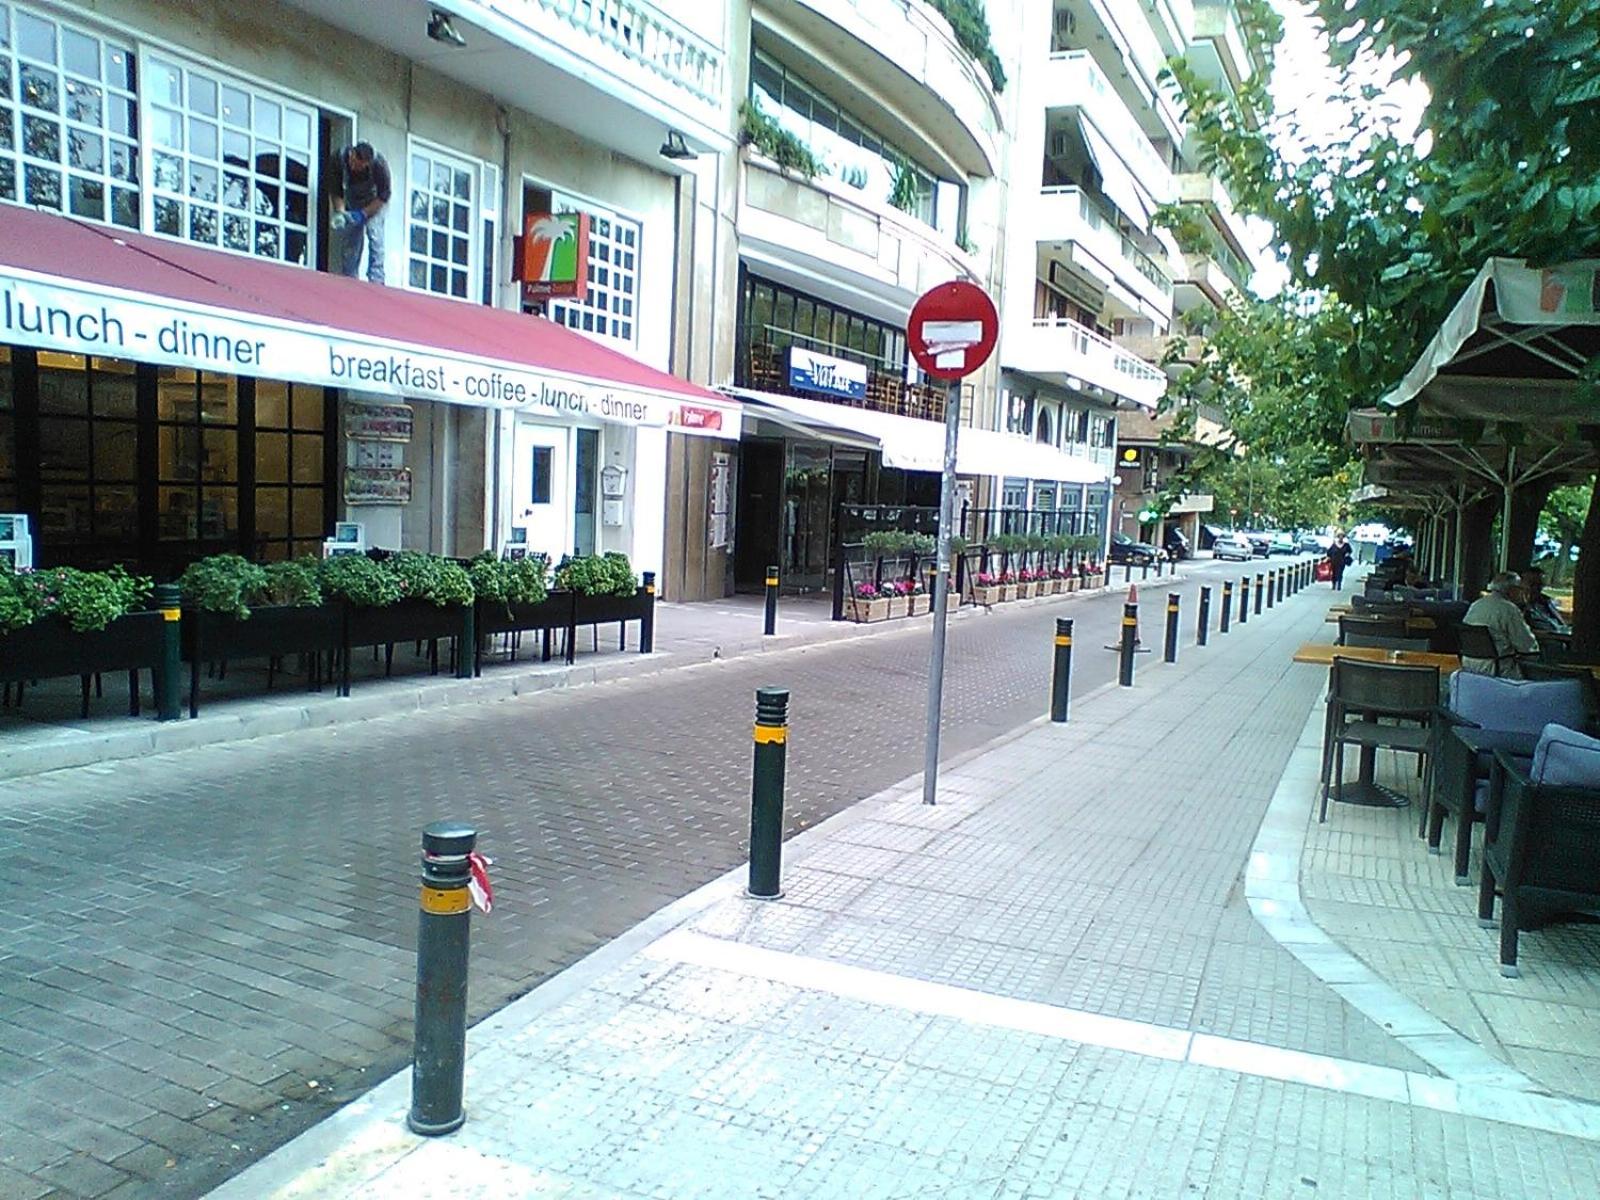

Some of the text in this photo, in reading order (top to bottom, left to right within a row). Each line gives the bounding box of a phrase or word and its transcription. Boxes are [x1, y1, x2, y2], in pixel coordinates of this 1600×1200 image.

[4, 289, 125, 347] lunch
[158, 319, 267, 366] dinner
[329, 345, 447, 393] breakfast
[465, 372, 527, 403] coffee
[540, 381, 589, 413] lunch
[600, 393, 648, 420] dinner
